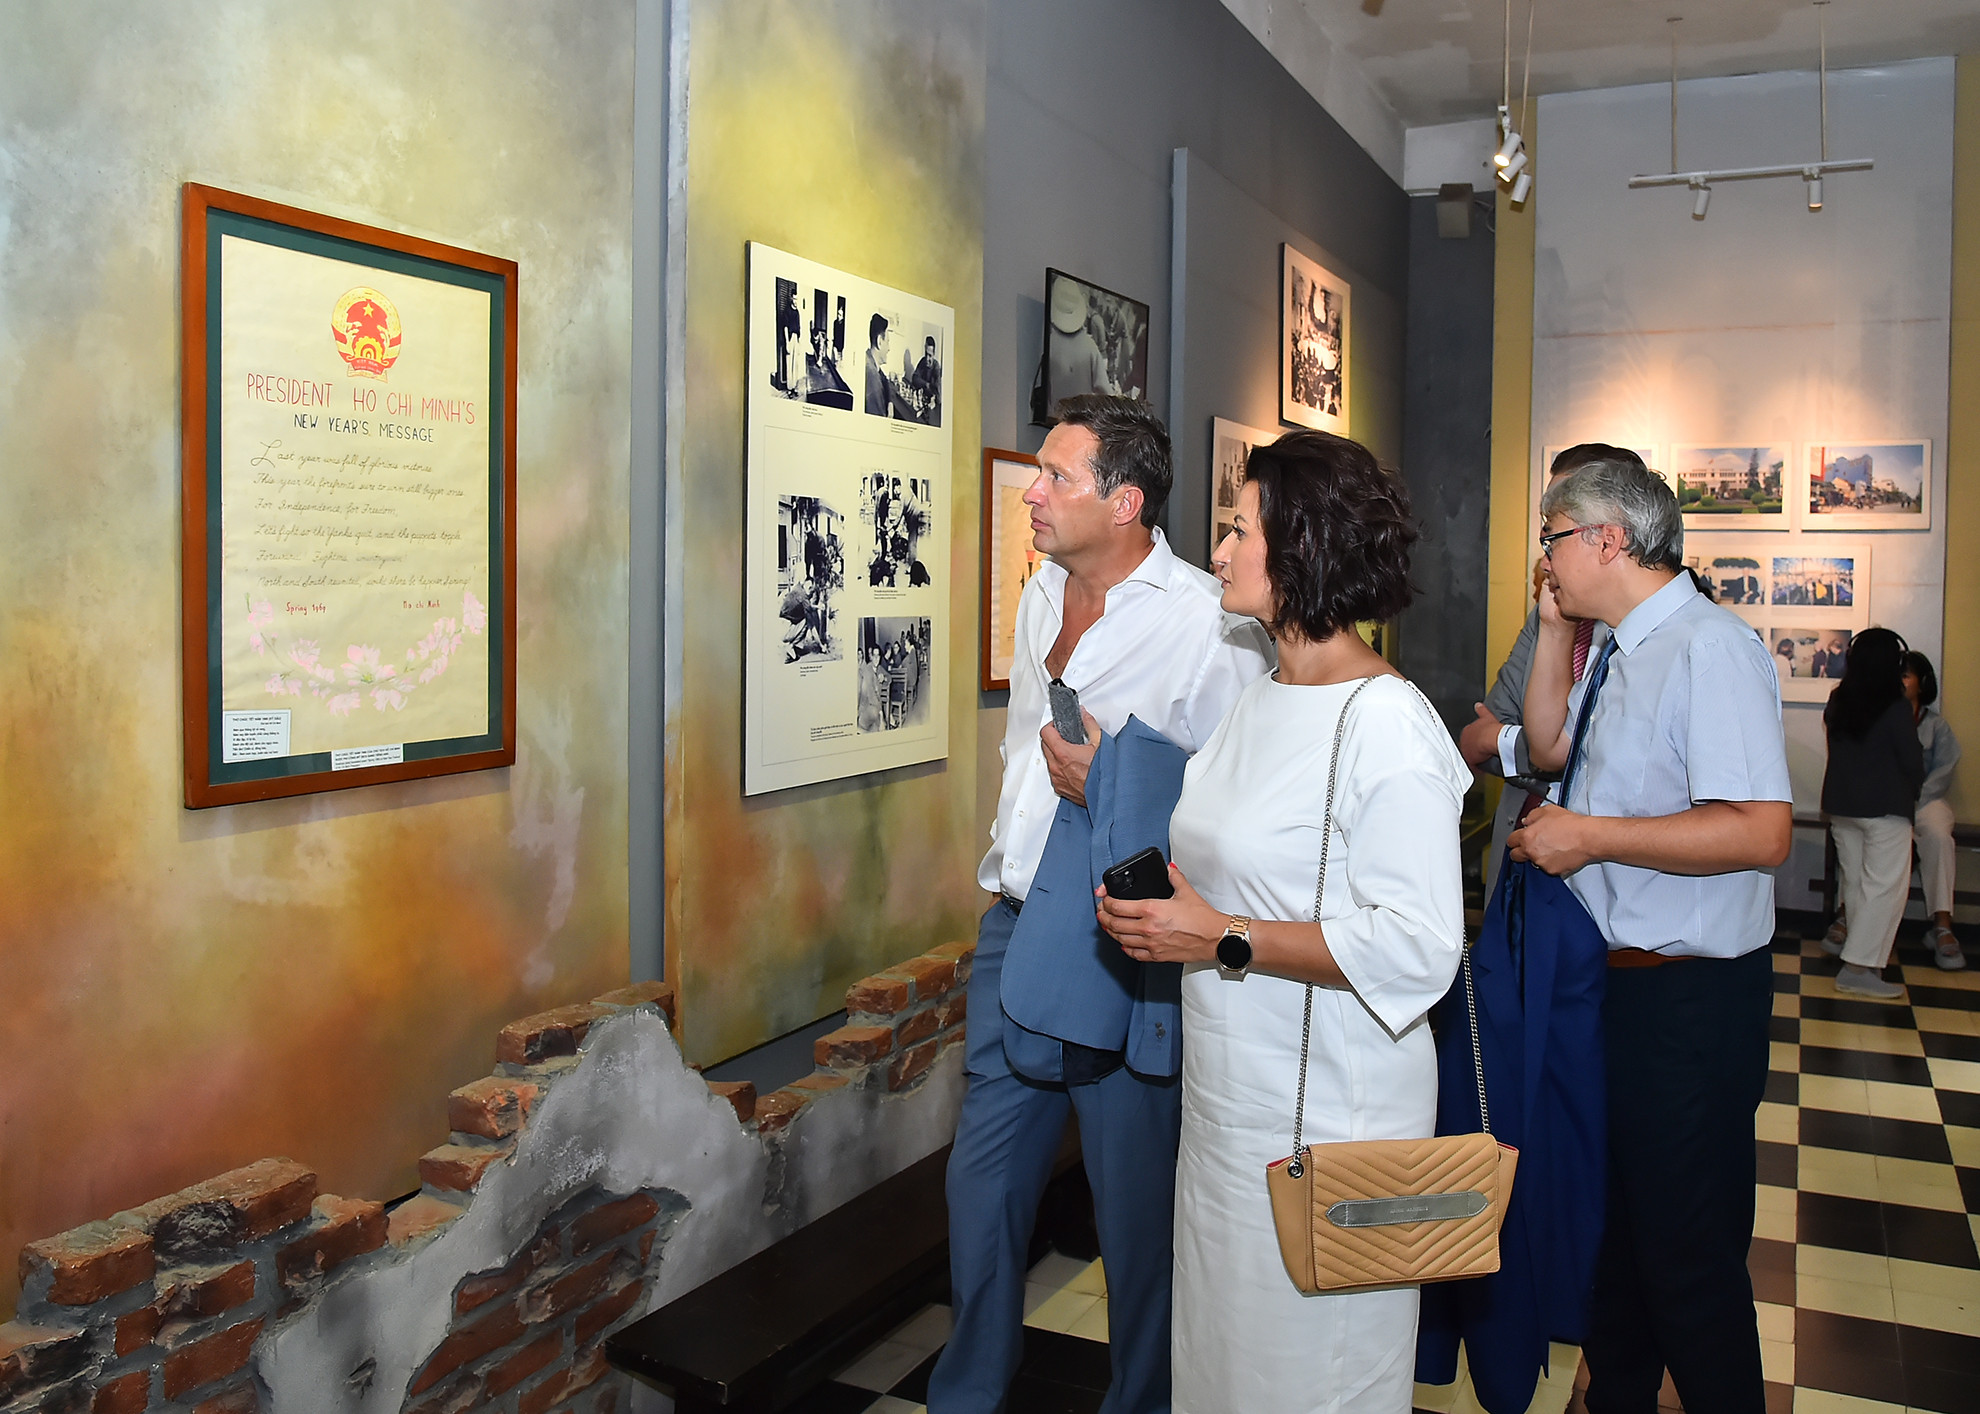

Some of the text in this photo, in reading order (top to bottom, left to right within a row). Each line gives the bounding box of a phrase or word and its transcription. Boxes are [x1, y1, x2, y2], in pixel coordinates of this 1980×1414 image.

[247, 372, 475, 424] PRESIDENT HO CHI MINH'S
[294, 413, 434, 443] NEW YEAR'S MESSAGE
[251, 439, 295, 468] Last
[298, 456, 320, 470] year
[253, 472, 275, 485] This
[279, 479, 301, 493] year
[286, 601, 326, 615] Spring 1969
